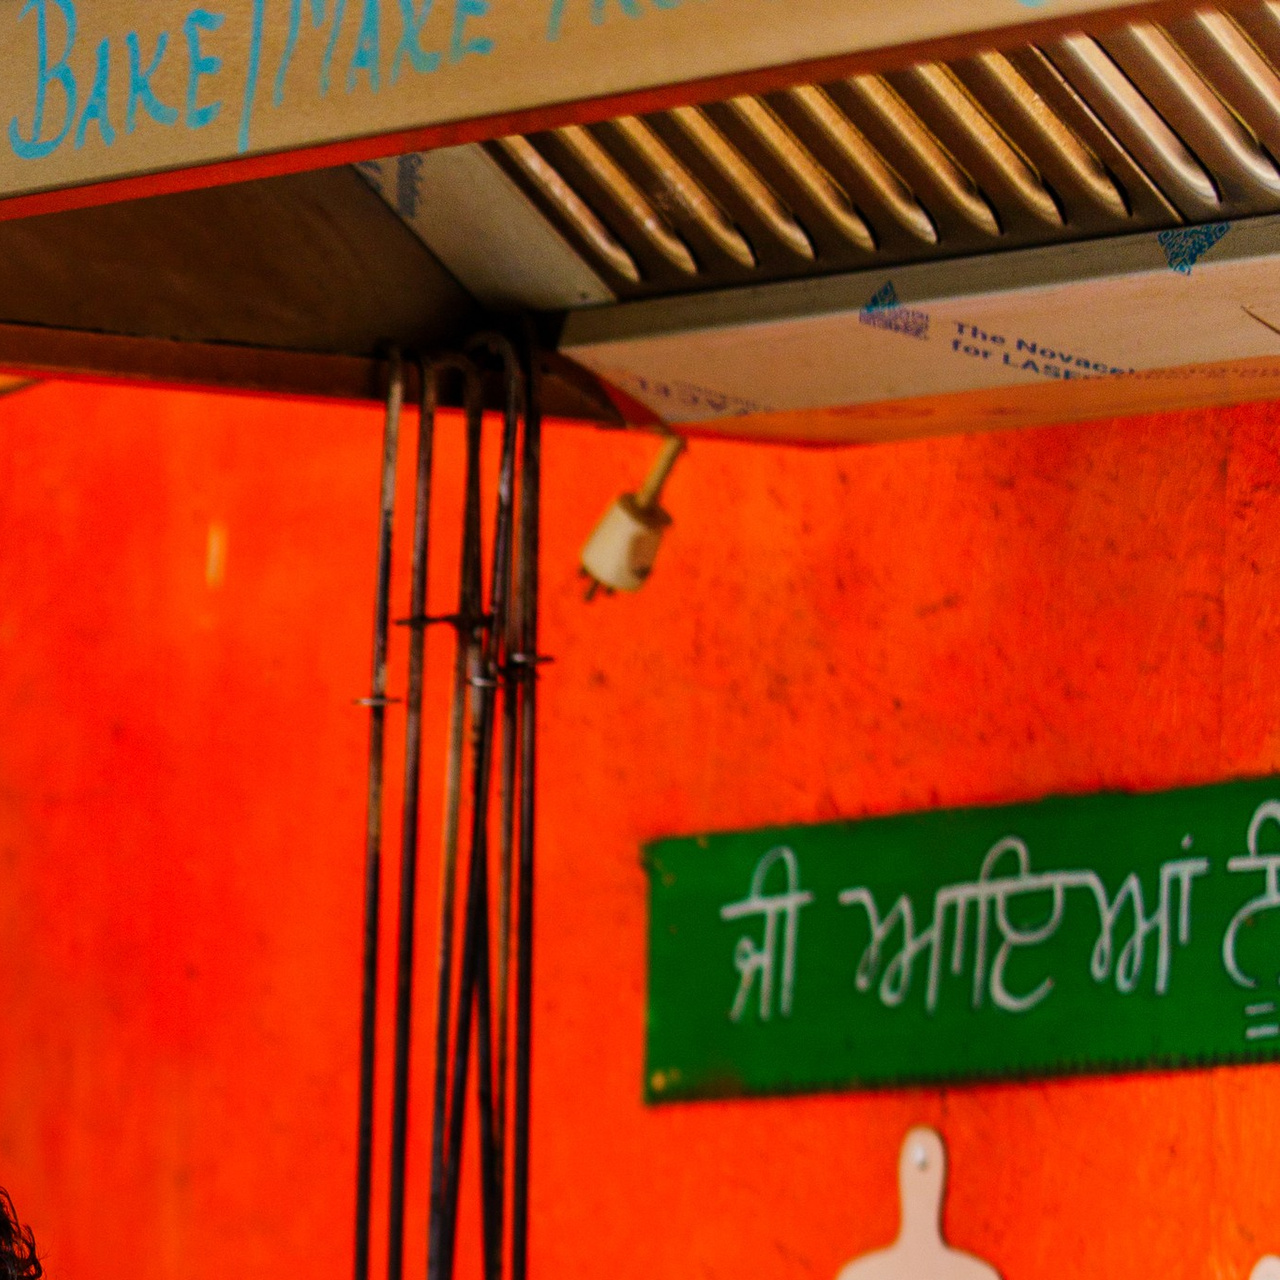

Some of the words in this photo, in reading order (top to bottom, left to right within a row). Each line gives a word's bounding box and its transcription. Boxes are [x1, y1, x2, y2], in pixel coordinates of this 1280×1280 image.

[953, 320, 1006, 346] The
[950, 338, 992, 361] for
[1001, 351, 1090, 381] LASE
